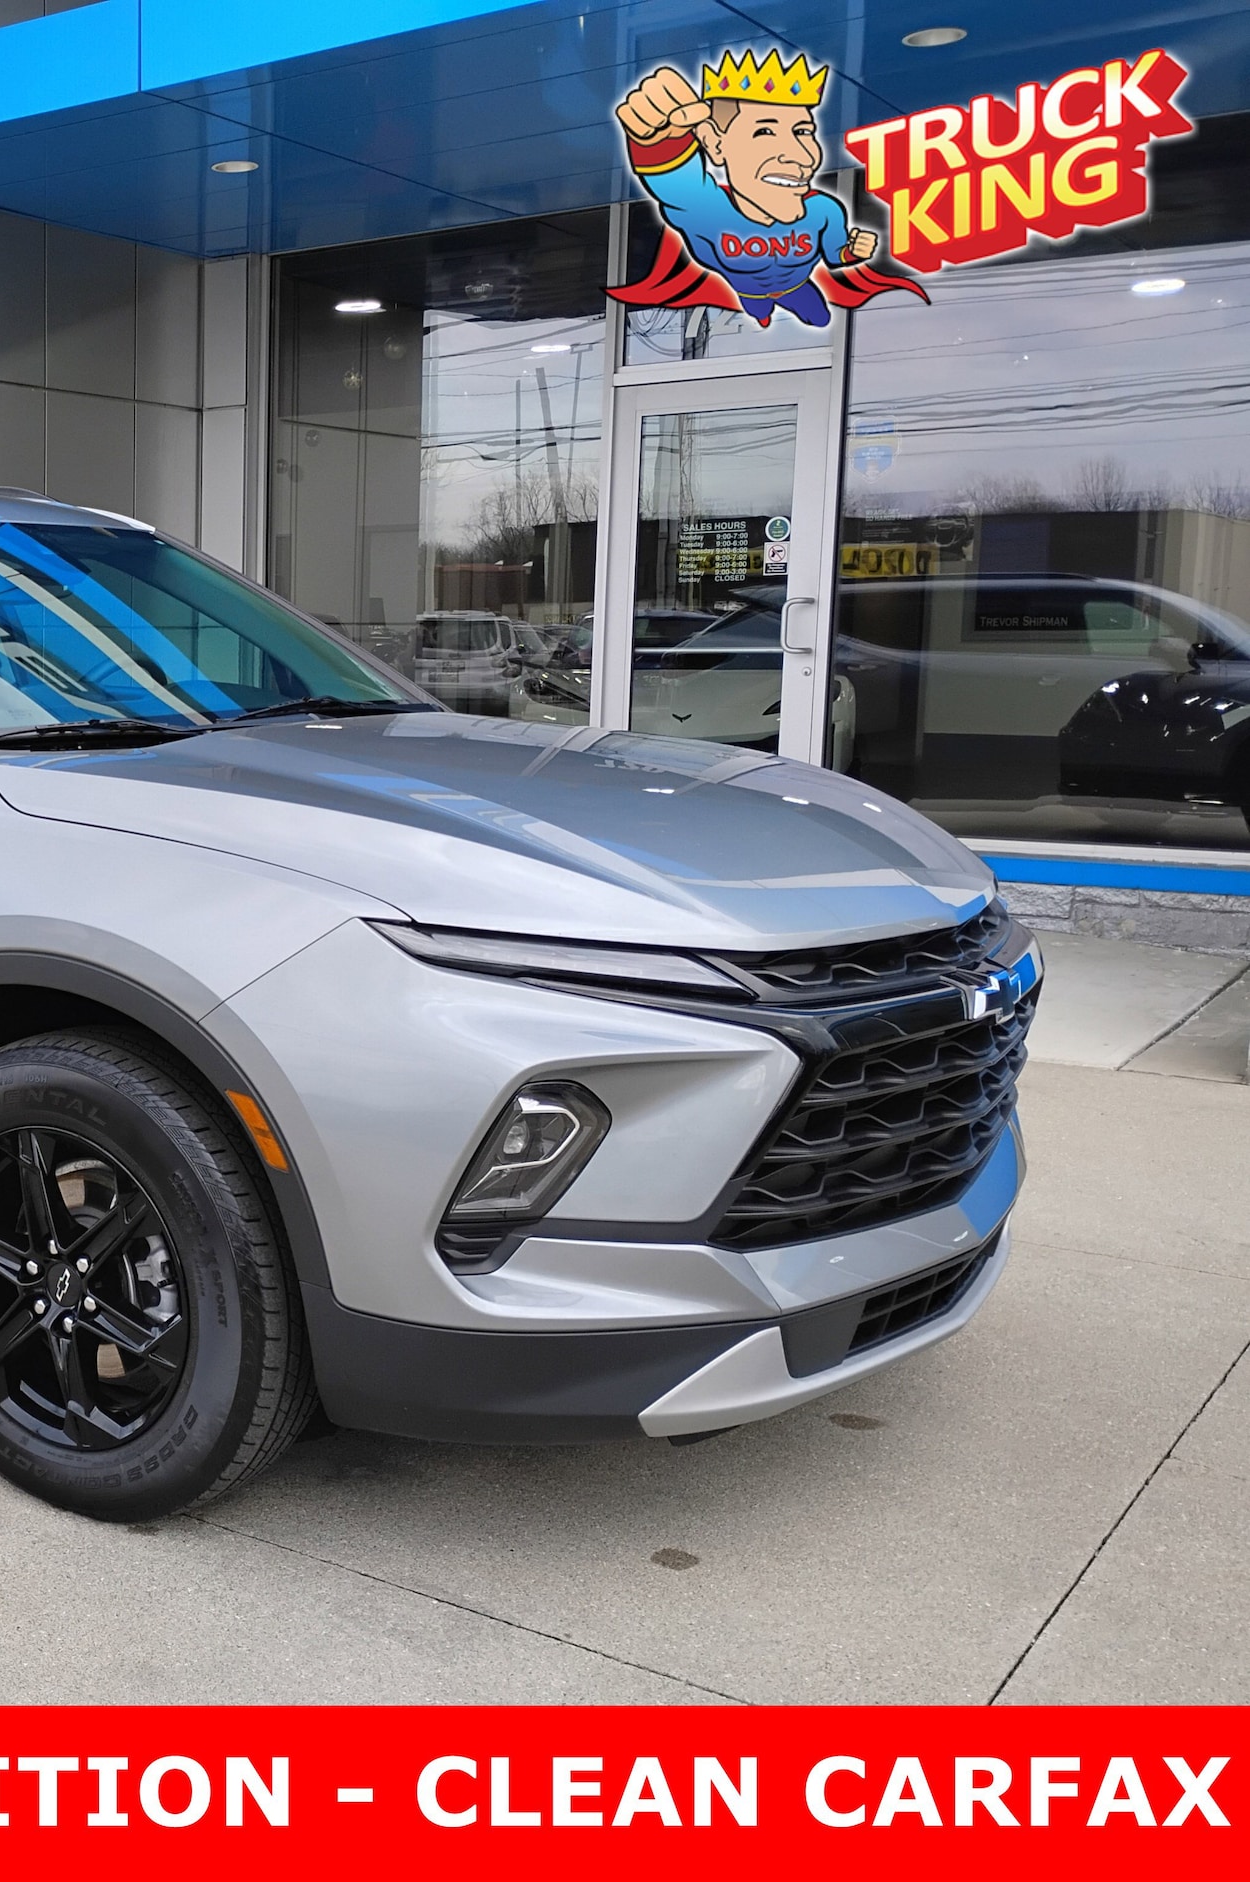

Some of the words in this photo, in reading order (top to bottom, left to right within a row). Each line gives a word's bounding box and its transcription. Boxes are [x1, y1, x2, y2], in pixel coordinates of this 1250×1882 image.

[683, 523, 712, 532] SALES
[714, 521, 746, 531] HOURS
[680, 534, 704, 542] Monday
[679, 547, 714, 555] Wednesday
[679, 562, 698, 570] Friday
[678, 569, 705, 577] Saturday
[678, 576, 701, 584] Sunday
[714, 574, 745, 582] CLOSED
